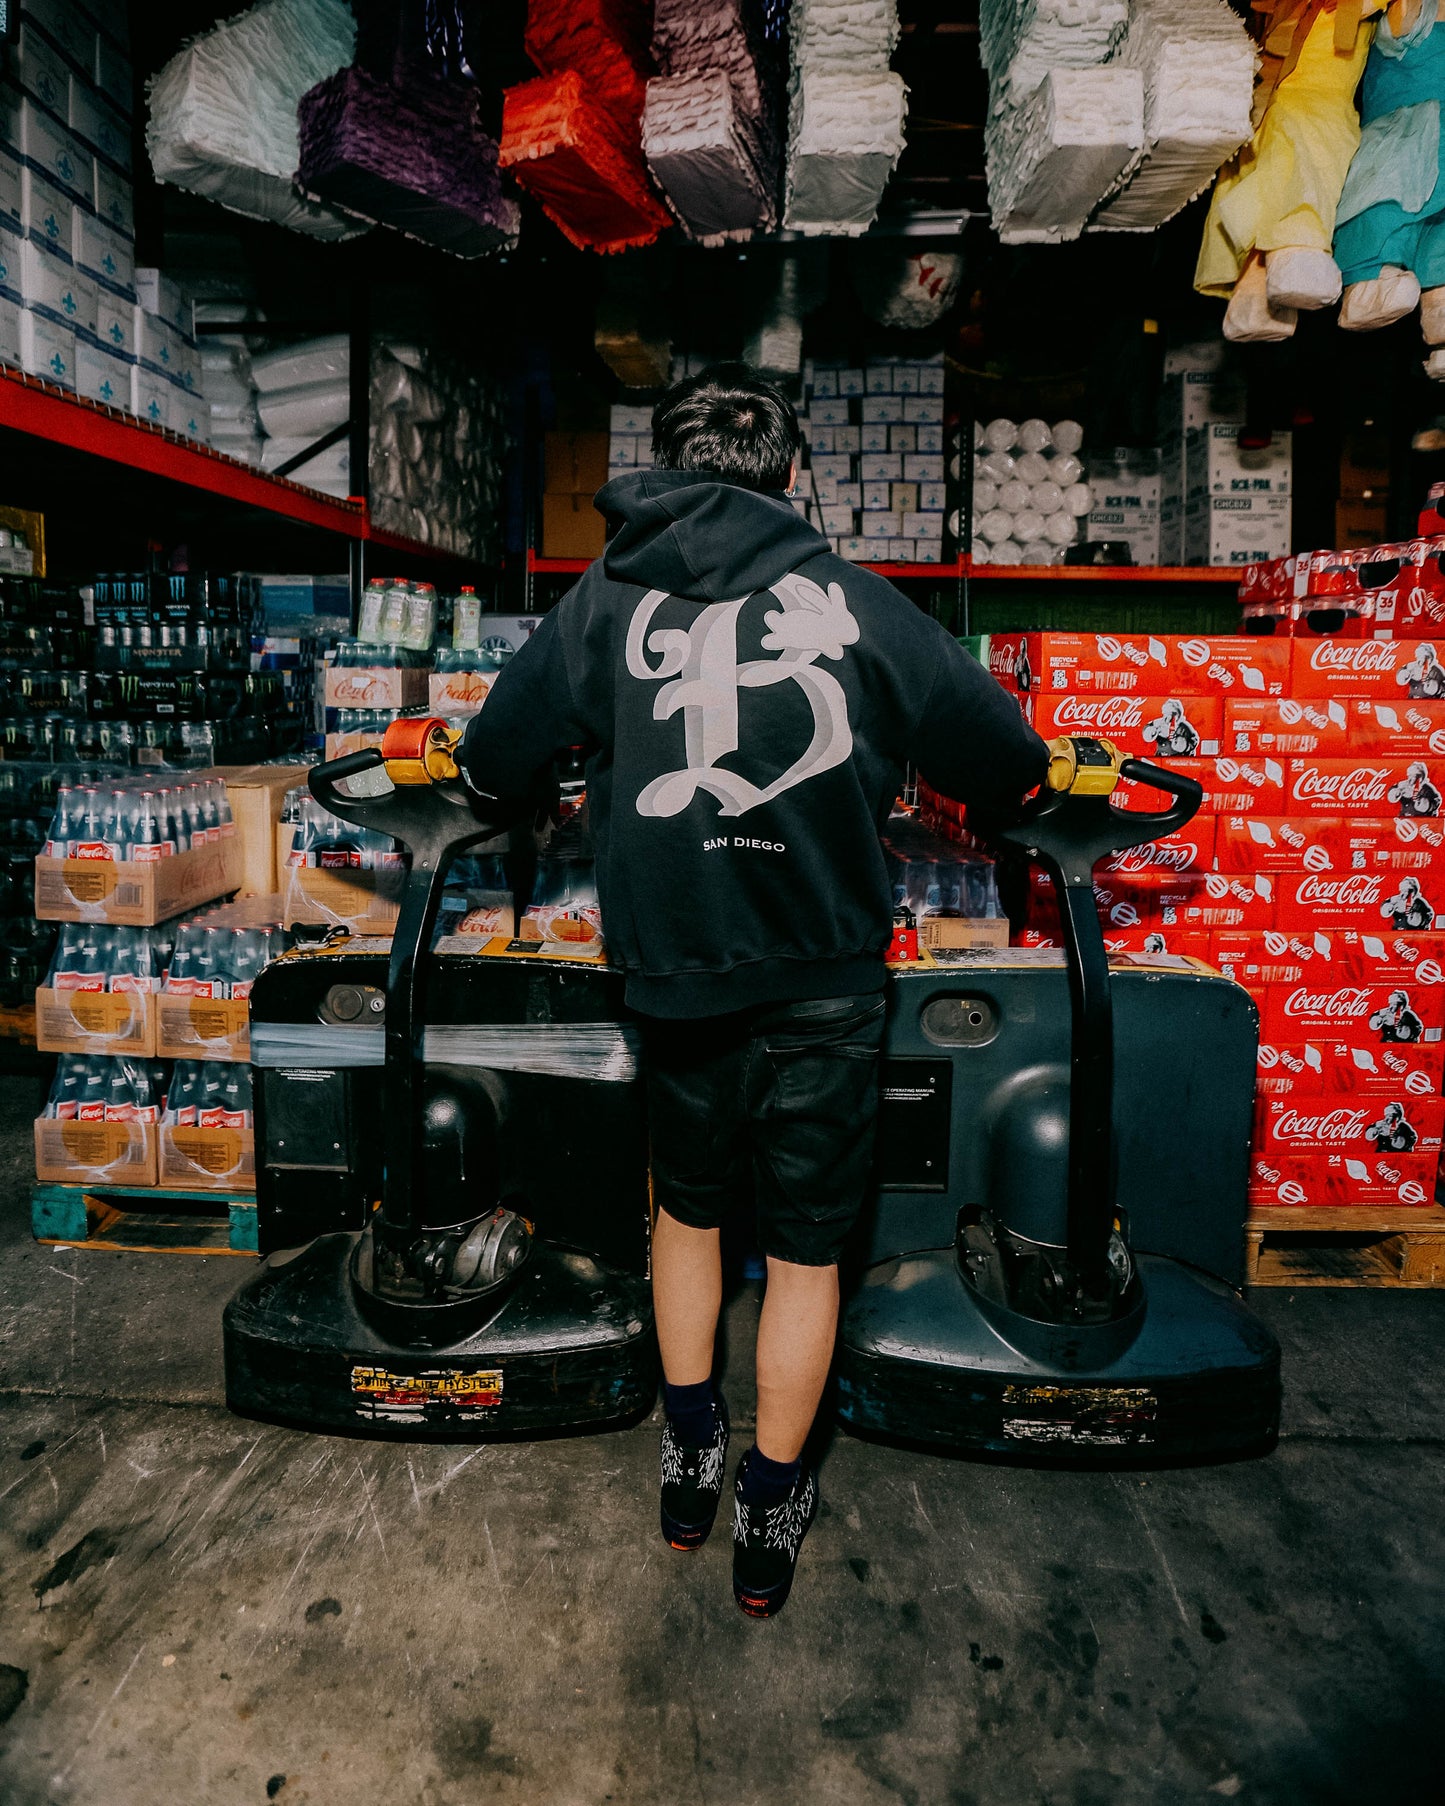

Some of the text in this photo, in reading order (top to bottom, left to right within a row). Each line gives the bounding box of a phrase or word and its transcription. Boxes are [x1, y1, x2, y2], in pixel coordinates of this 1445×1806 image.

[1297, 561, 1309, 571] 35
[1379, 597, 1394, 608] 35
[133, 649, 182, 657] MONSTER
[1310, 640, 1400, 671] Coca-Cola
[1053, 696, 1148, 727] Coca-Cola
[1291, 759, 1304, 767] 24
[1293, 768, 1393, 801] Coca-Cola
[1231, 818, 1244, 826] 24
[703, 837, 785, 852] SAN DIEGO
[1037, 874, 1051, 882] 24
[1296, 875, 1385, 905] Coca-Cola
[1027, 930, 1040, 938] 24
[1345, 932, 1358, 940] 24
[1284, 987, 1375, 1017] Coca-Cola
[1335, 1045, 1347, 1053] 24
[1272, 1109, 1370, 1140] Coca-Cola
[1328, 1155, 1340, 1163] 24
